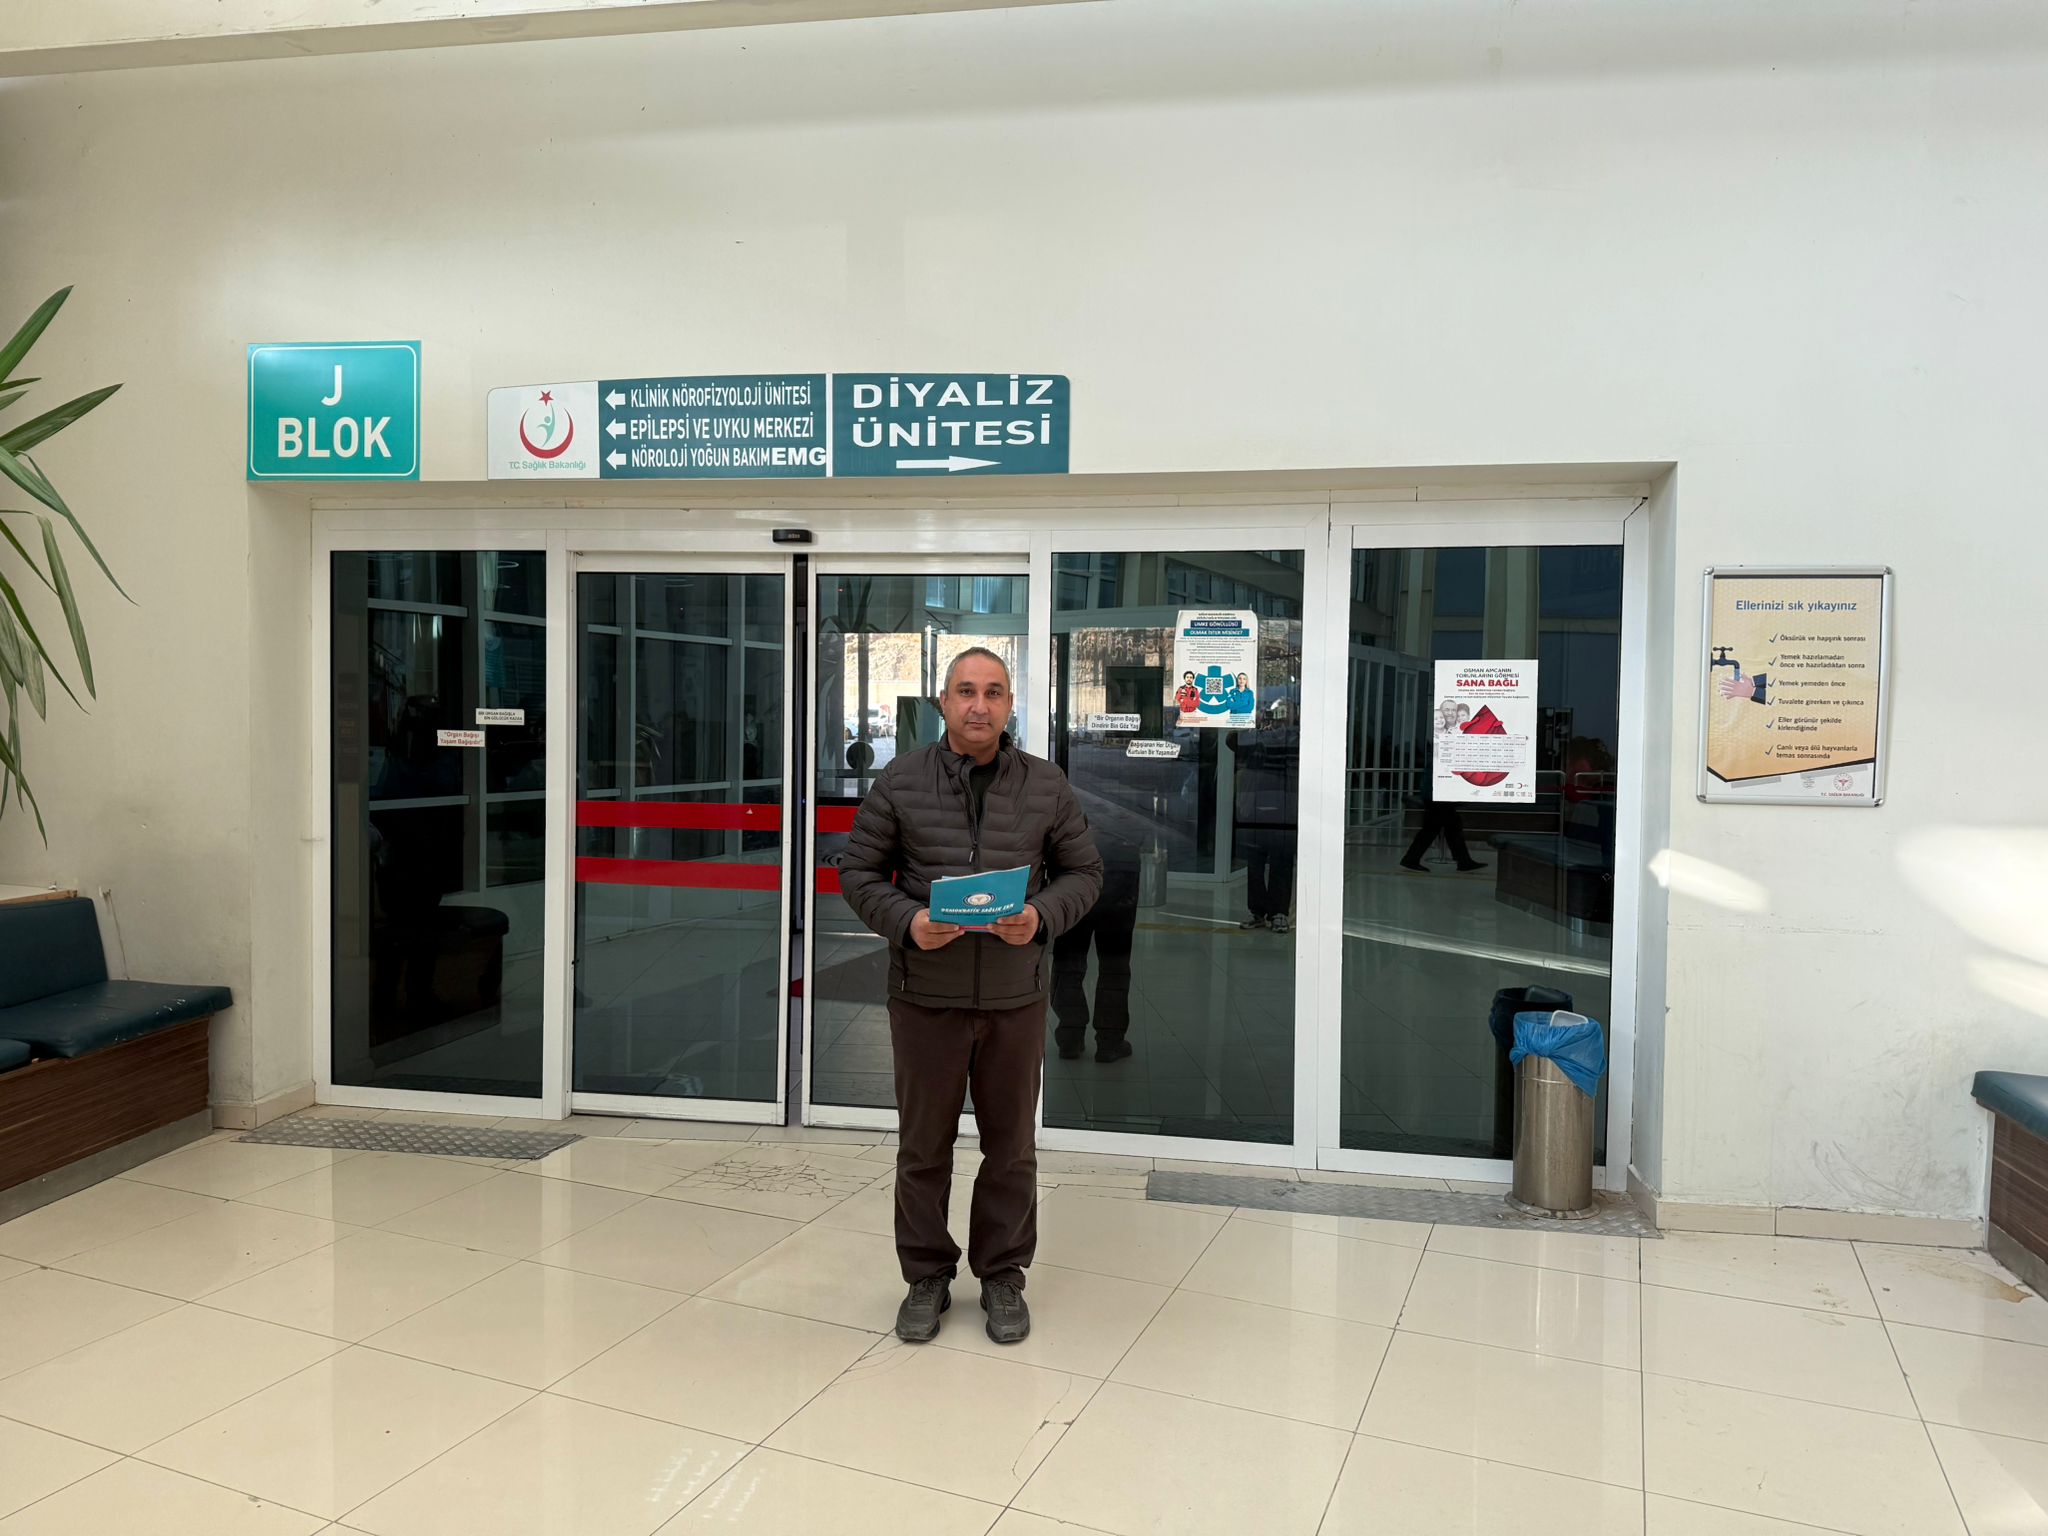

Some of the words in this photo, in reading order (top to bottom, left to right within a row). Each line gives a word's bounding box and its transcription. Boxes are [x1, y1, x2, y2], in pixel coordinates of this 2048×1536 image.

[321, 364, 343, 406] J
[631, 383, 669, 407] KLİNİK
[672, 382, 761, 406] NÖROFİZYOLOJİ
[765, 380, 811, 405] ÜNİTESİ
[853, 374, 1053, 409] DİYALİZ
[278, 416, 392, 458] BLOK
[630, 413, 689, 440] EPİLEPSİ
[693, 418, 710, 439] VE
[713, 417, 750, 439] UYKU
[754, 411, 814, 438] MERKEZİ
[853, 413, 1050, 447] ÜNİTESİ
[522, 460, 547, 471] Sağlık
[549, 460, 586, 471] Bakanlığı
[632, 443, 688, 467] NÖROLOJİ
[690, 443, 730, 467] YOĞUN
[1736, 600, 1784, 611] Ellerinizi
[1788, 600, 1804, 611] sık
[1807, 600, 1857, 613] yıkayınız
[1456, 679, 1486, 687] SANA
[1488, 677, 1518, 687] BAĞLI
